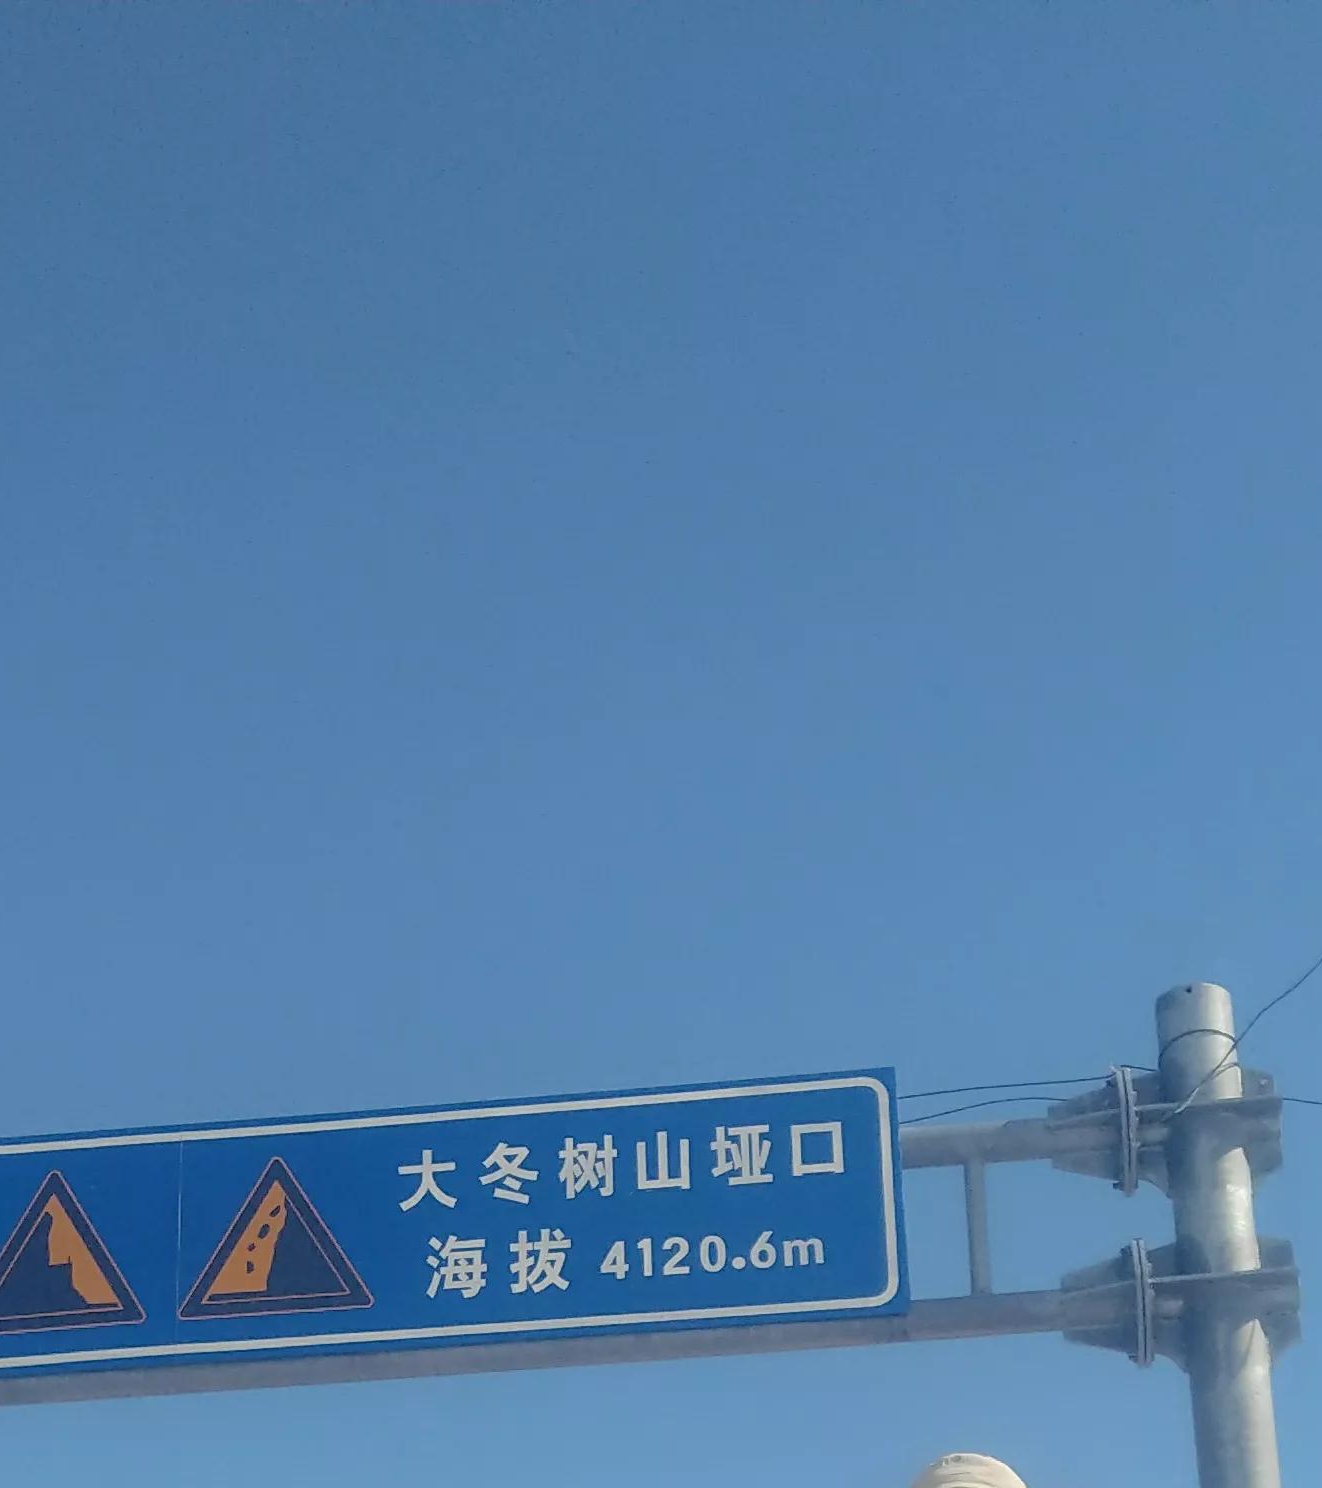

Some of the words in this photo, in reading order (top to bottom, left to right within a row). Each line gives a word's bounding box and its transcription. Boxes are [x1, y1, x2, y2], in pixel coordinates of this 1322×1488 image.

[397, 1121, 845, 1213] 大冬树山垭口
[426, 1228, 573, 1299] 海拔
[600, 1230, 825, 1280] 4120.6m
